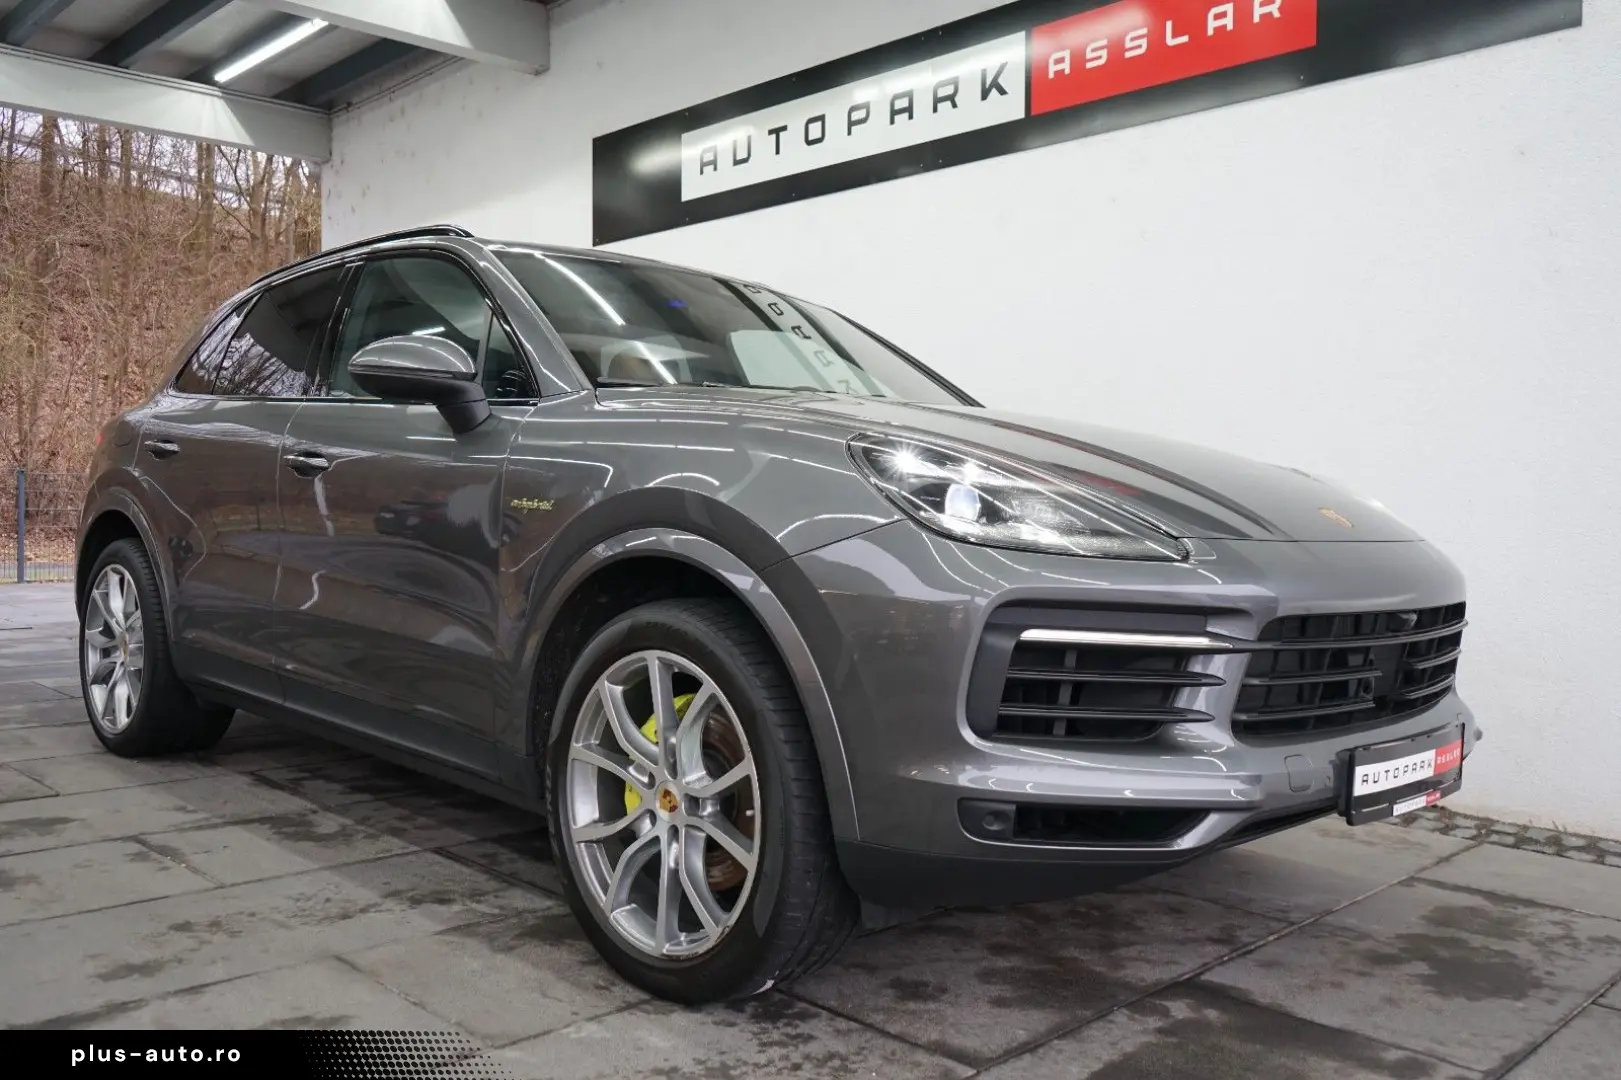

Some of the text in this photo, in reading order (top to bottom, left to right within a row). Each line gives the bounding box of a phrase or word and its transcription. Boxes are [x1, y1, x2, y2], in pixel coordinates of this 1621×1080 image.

[699, 0, 1283, 175] AUTOPARK ASSLAR
[1361, 760, 1433, 786] AUTOPARK
